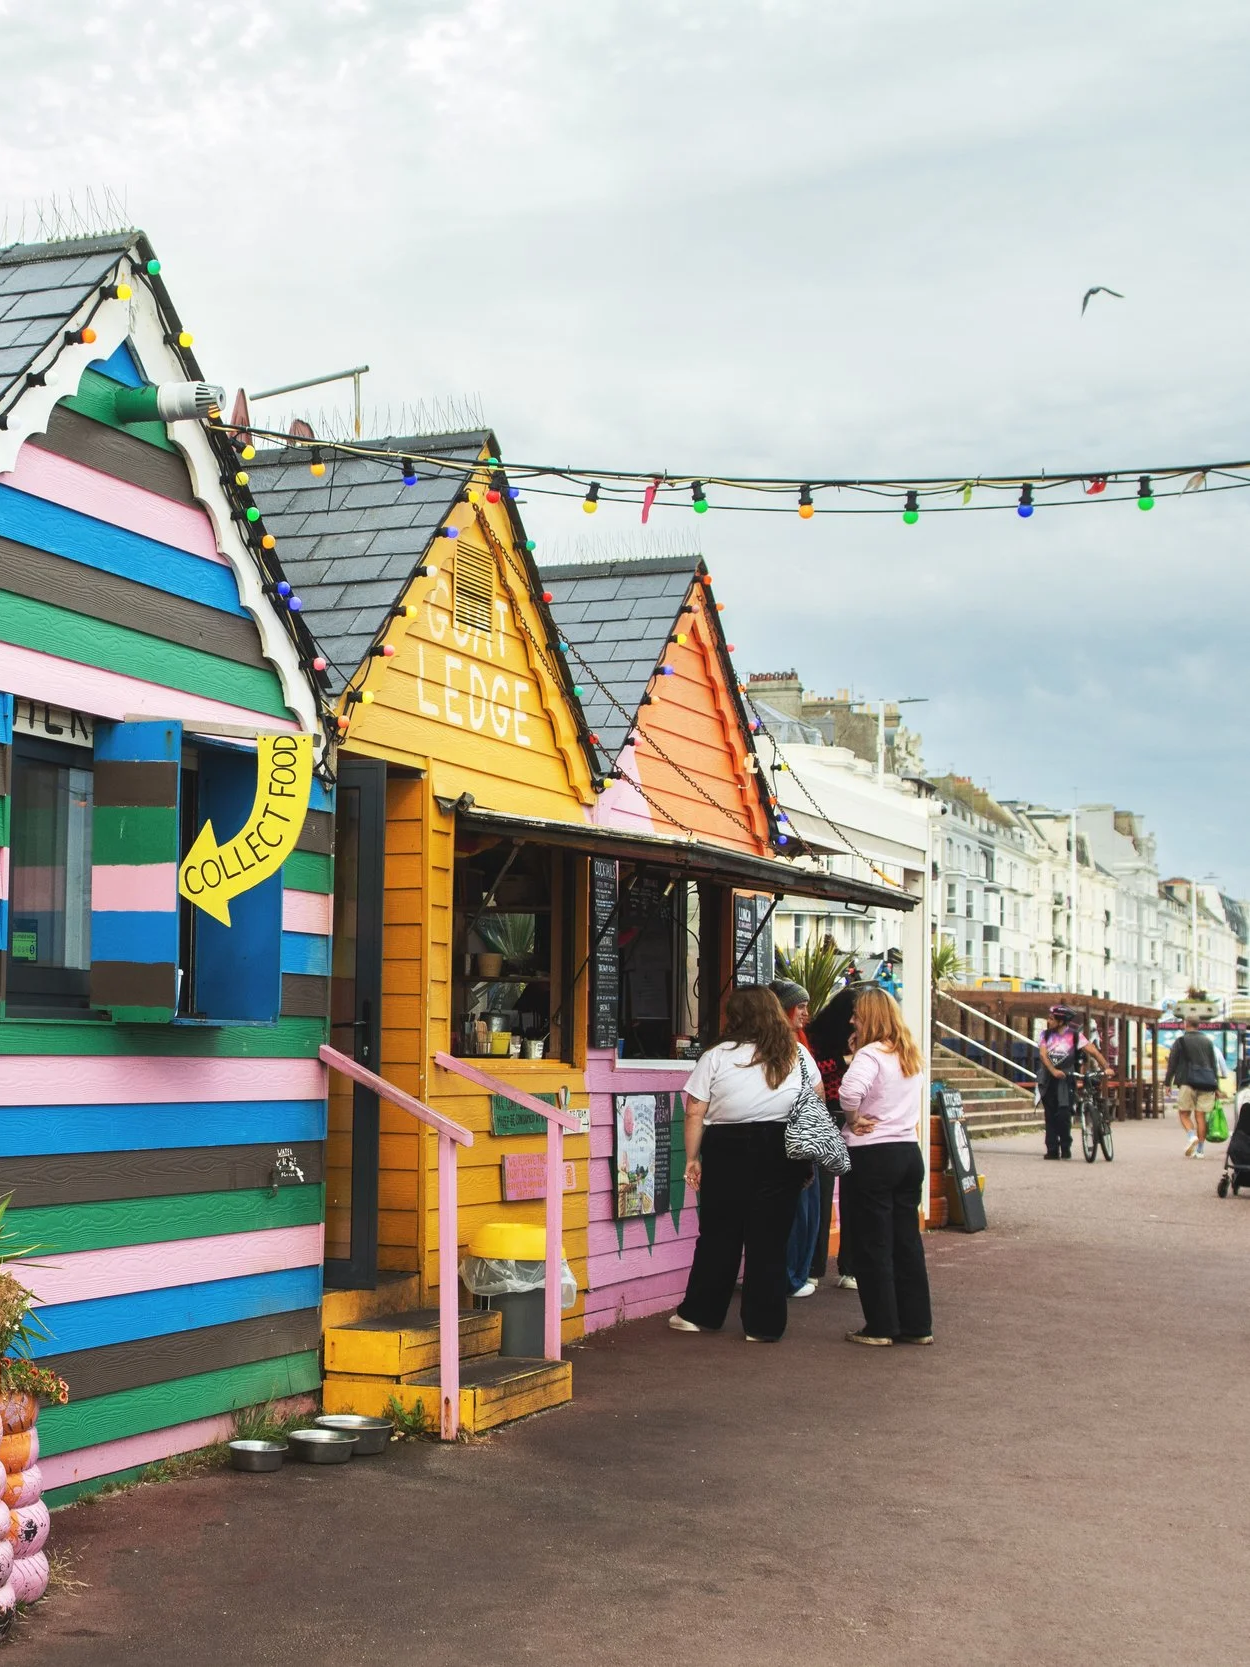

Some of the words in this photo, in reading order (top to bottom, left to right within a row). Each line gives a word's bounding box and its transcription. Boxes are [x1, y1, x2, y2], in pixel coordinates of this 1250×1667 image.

[417, 643, 530, 746] LEDGE
[184, 803, 290, 894] COLLECT
[269, 736, 298, 797] FOOD
